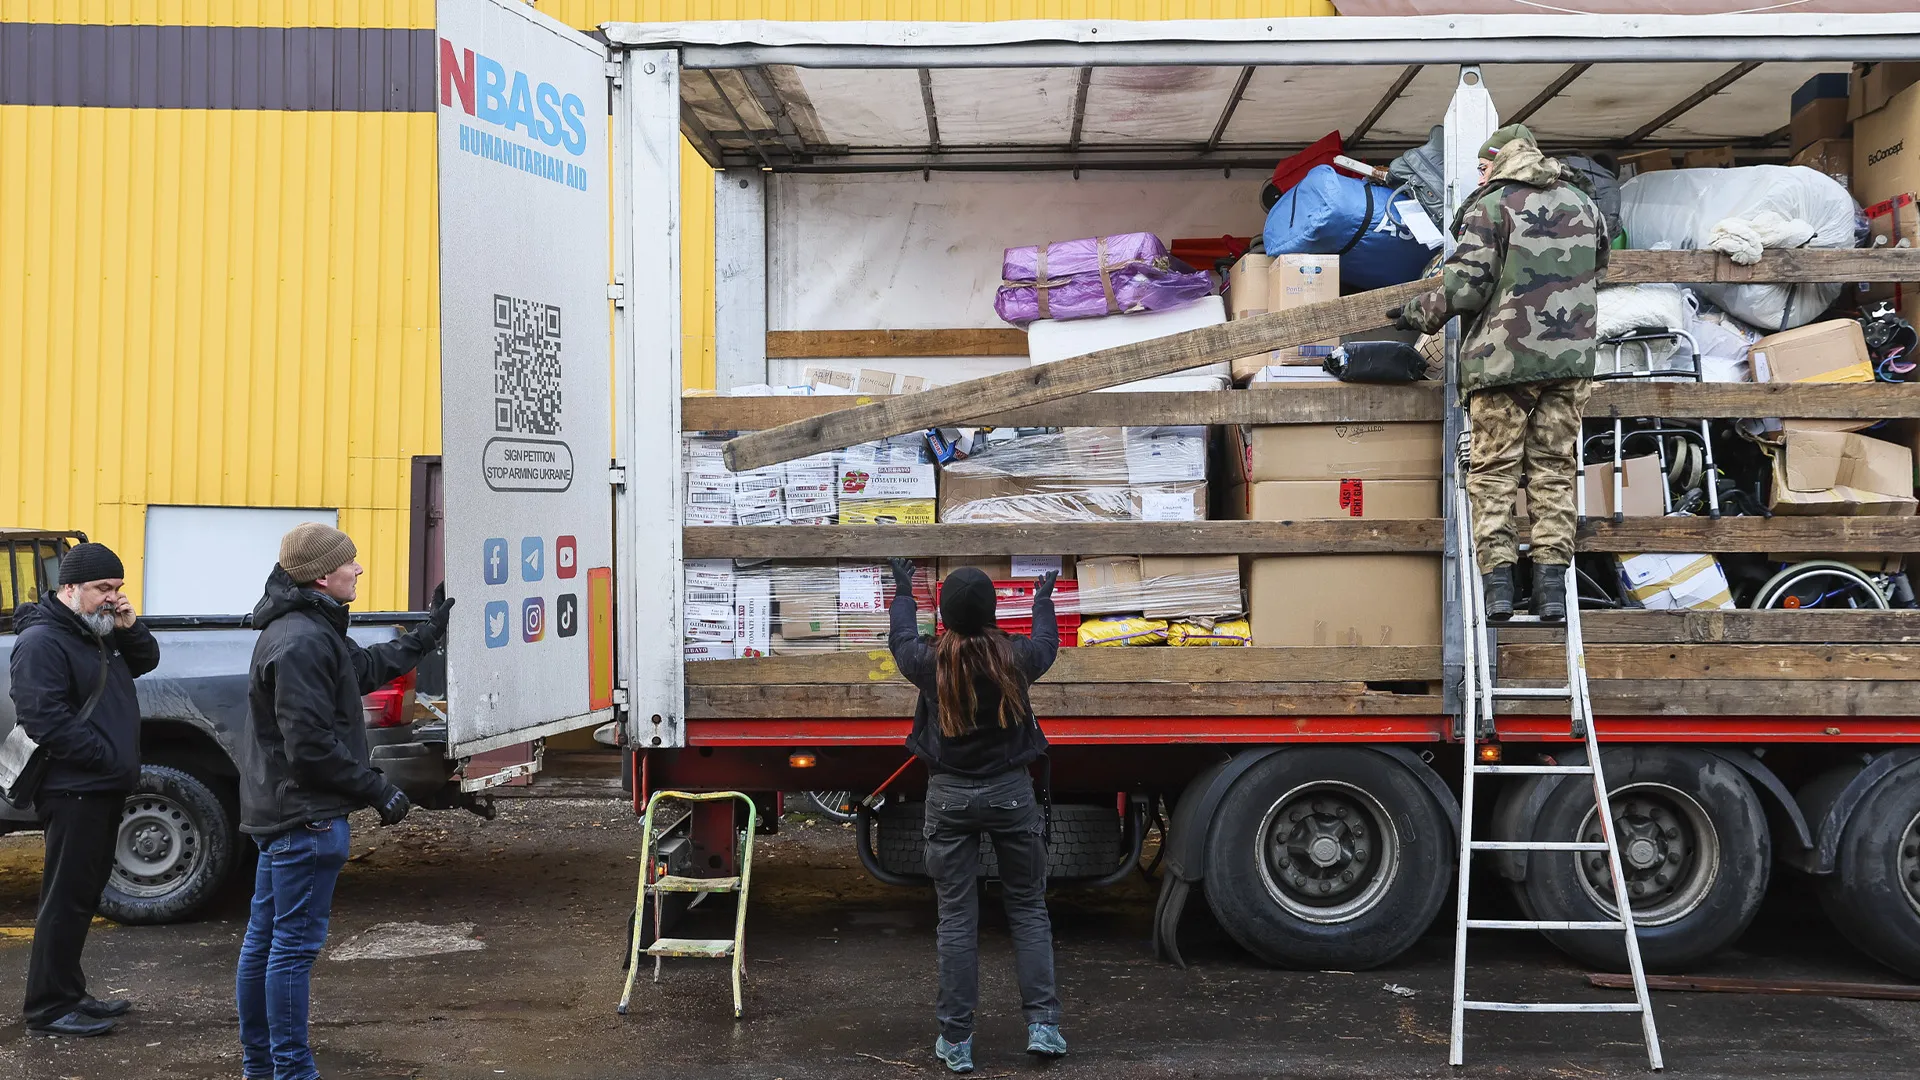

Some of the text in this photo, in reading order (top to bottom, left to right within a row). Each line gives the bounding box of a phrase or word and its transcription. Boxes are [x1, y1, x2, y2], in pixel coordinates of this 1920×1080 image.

[440, 37, 587, 157] NBASS
[460, 124, 587, 192] HUMANITARIAN AID
[1868, 138, 1904, 167] BoConcept
[504, 449, 555, 463] SIGN PETITION
[930, 435, 943, 456] HARIBO
[487, 467, 571, 480] STOP ARMING UKRAINE
